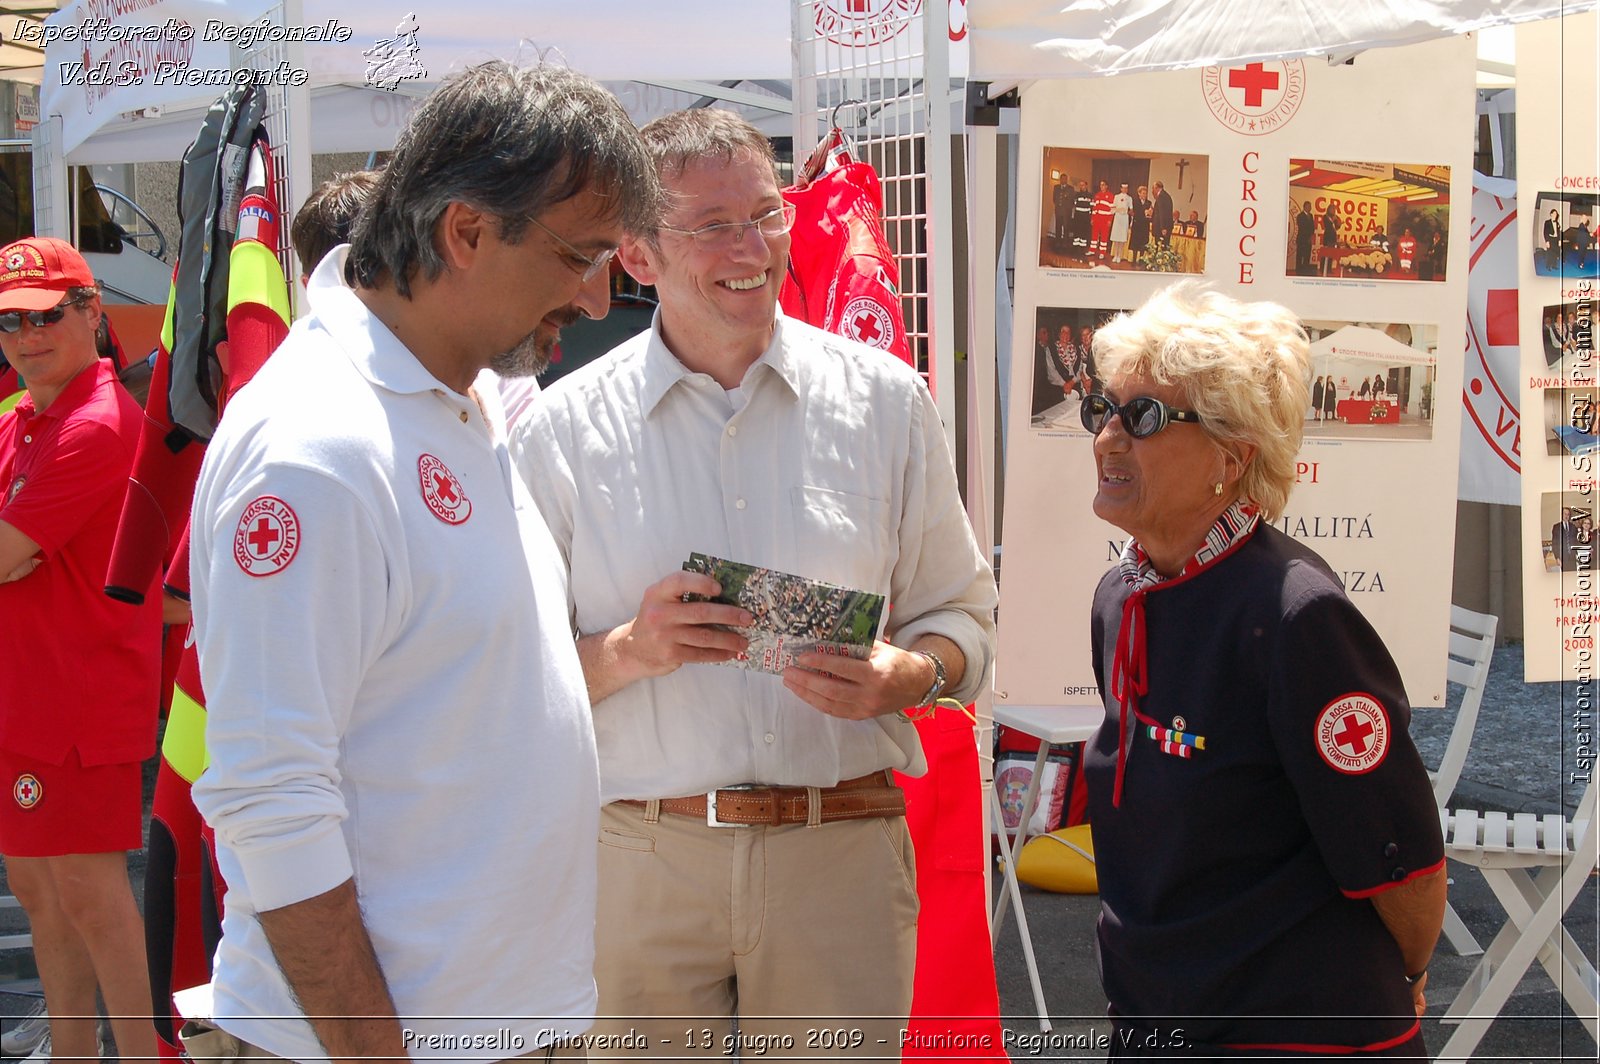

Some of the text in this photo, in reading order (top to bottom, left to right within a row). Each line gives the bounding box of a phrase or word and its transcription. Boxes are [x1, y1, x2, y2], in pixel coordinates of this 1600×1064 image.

[1238, 151, 1259, 284] CROCE
[1313, 213, 1383, 234] RSSA
[1314, 196, 1379, 218] CROCE
[426, 492, 457, 521] CROCE
[236, 500, 296, 569] CROCE ROSSA ITALIANA
[1565, 637, 1594, 651] 2008
[1321, 701, 1382, 744] CROCE ROSSA ITALIANA
[1327, 726, 1384, 767] COMITATO FEMMINILE
